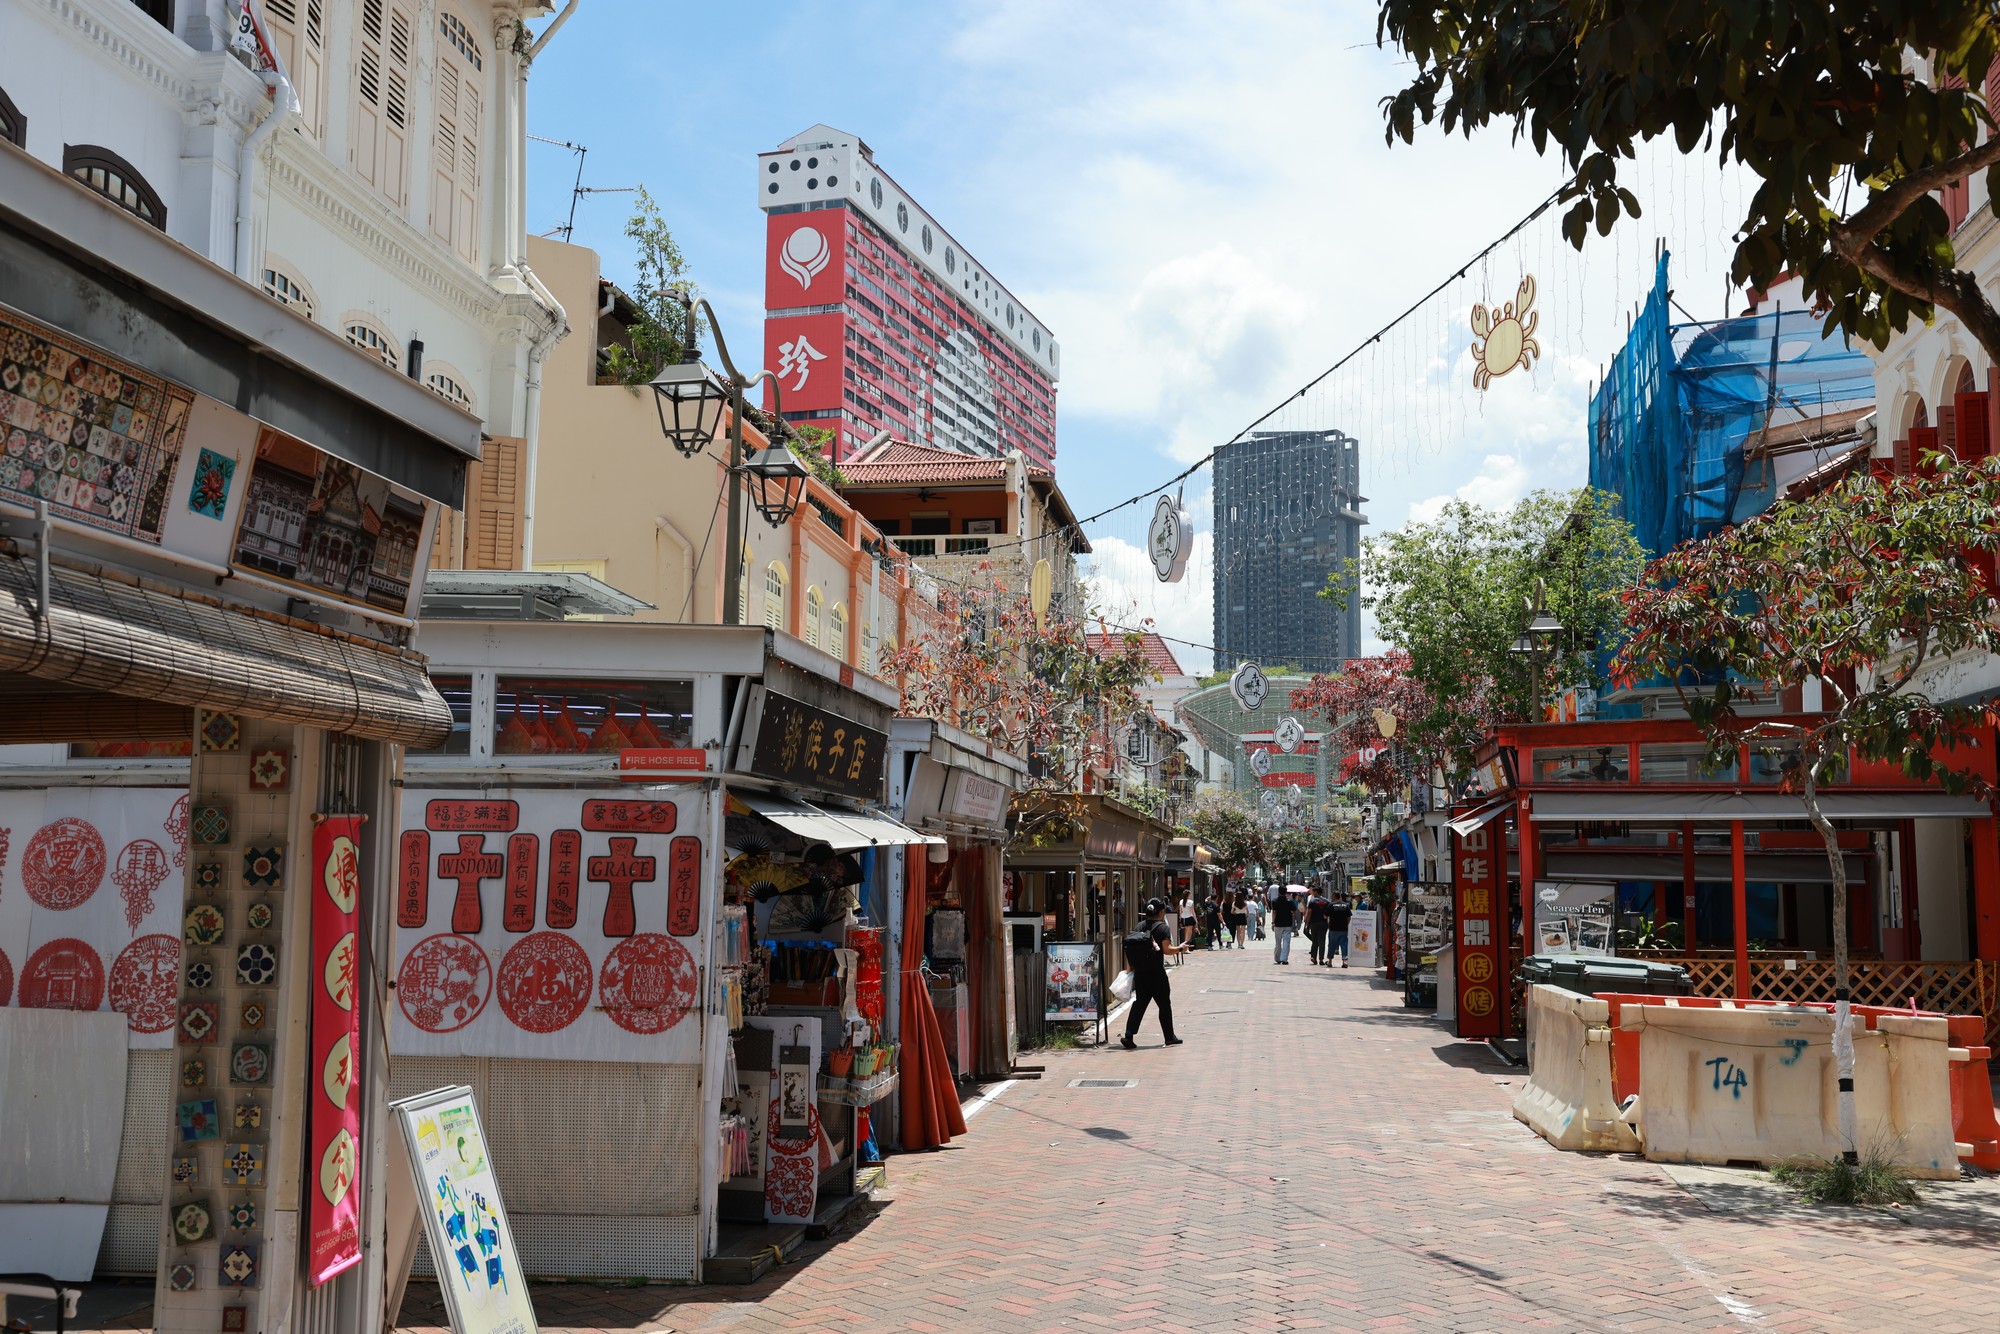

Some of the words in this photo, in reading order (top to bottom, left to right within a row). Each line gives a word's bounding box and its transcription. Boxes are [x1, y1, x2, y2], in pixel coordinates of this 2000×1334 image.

[778, 335, 828, 392] 珍
[805, 718, 867, 780] 筷子店
[626, 756, 646, 764] FIRE
[649, 756, 674, 764] HOSE
[677, 756, 700, 764] REEL
[442, 858, 498, 874] WISDOM
[592, 861, 650, 877] GRACE
[1077, 955, 1094, 963] Spot
